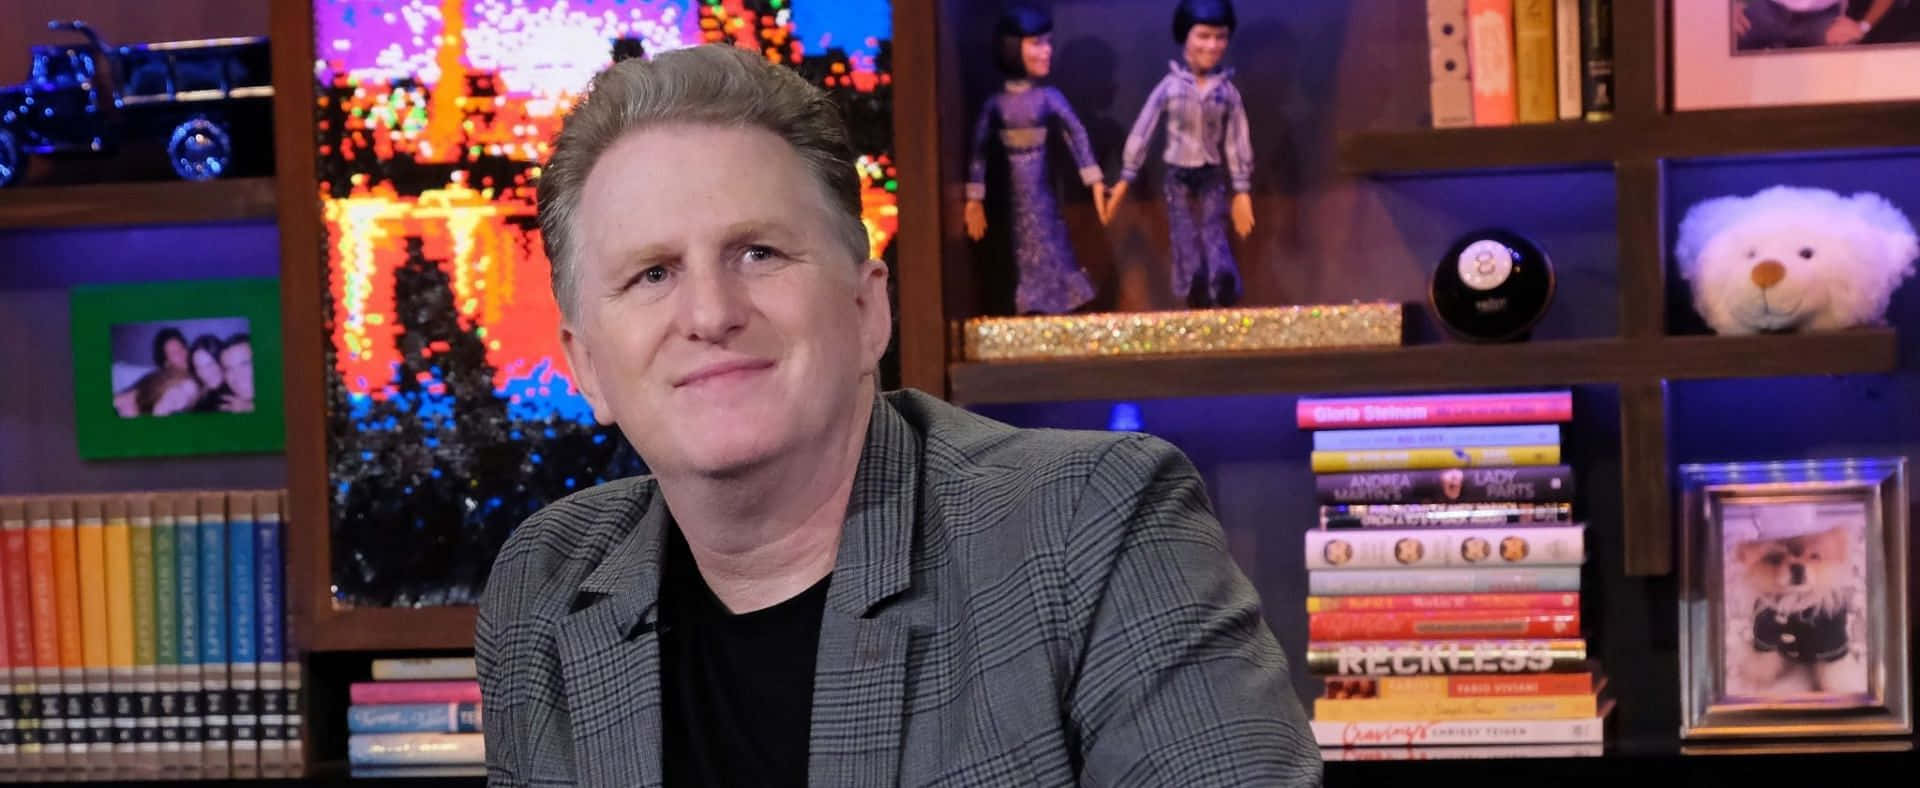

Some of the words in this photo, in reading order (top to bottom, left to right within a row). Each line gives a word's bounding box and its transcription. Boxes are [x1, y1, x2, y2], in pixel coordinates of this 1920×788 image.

[1475, 250, 1496, 275] 8
[1314, 407, 1360, 423] Gloria
[1363, 405, 1429, 421] Steinem
[1350, 475, 1411, 489] ANDREA
[1474, 471, 1518, 486] LADY
[1485, 483, 1535, 499] PARTS
[1337, 641, 1554, 675] RECKLESS
[1457, 683, 1494, 694] FABIO
[1500, 681, 1540, 693] VIVIANI
[1432, 727, 1481, 737] CHRISSY
[1485, 726, 1528, 736] TEIGEN
